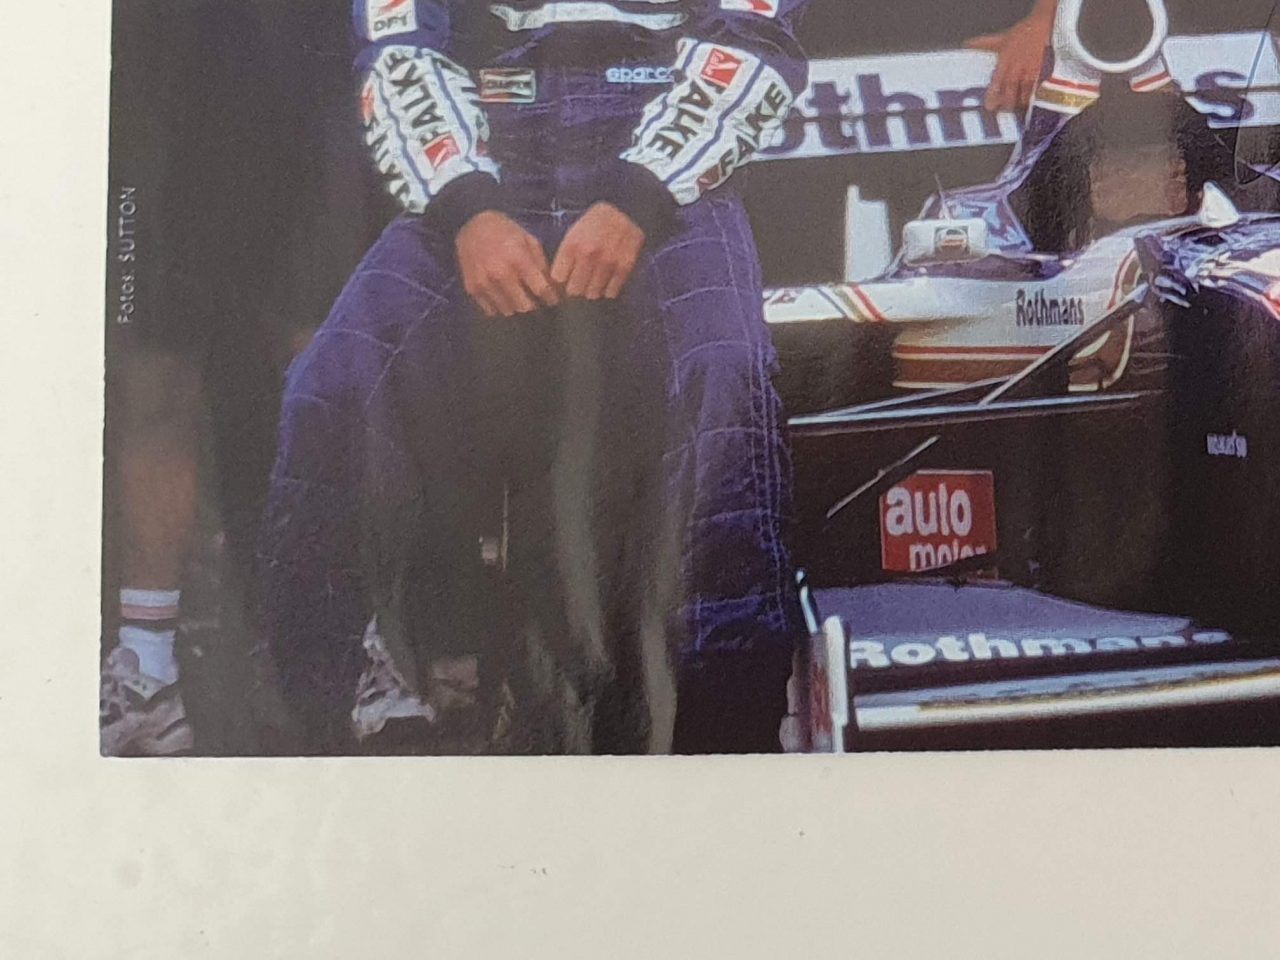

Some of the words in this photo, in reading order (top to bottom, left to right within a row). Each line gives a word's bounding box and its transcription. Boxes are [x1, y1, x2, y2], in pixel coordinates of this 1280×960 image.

[384, 51, 445, 146] FALKE
[118, 187, 136, 262] SUTTON
[1015, 288, 1085, 327] Rothmans
[886, 482, 972, 537] auto
